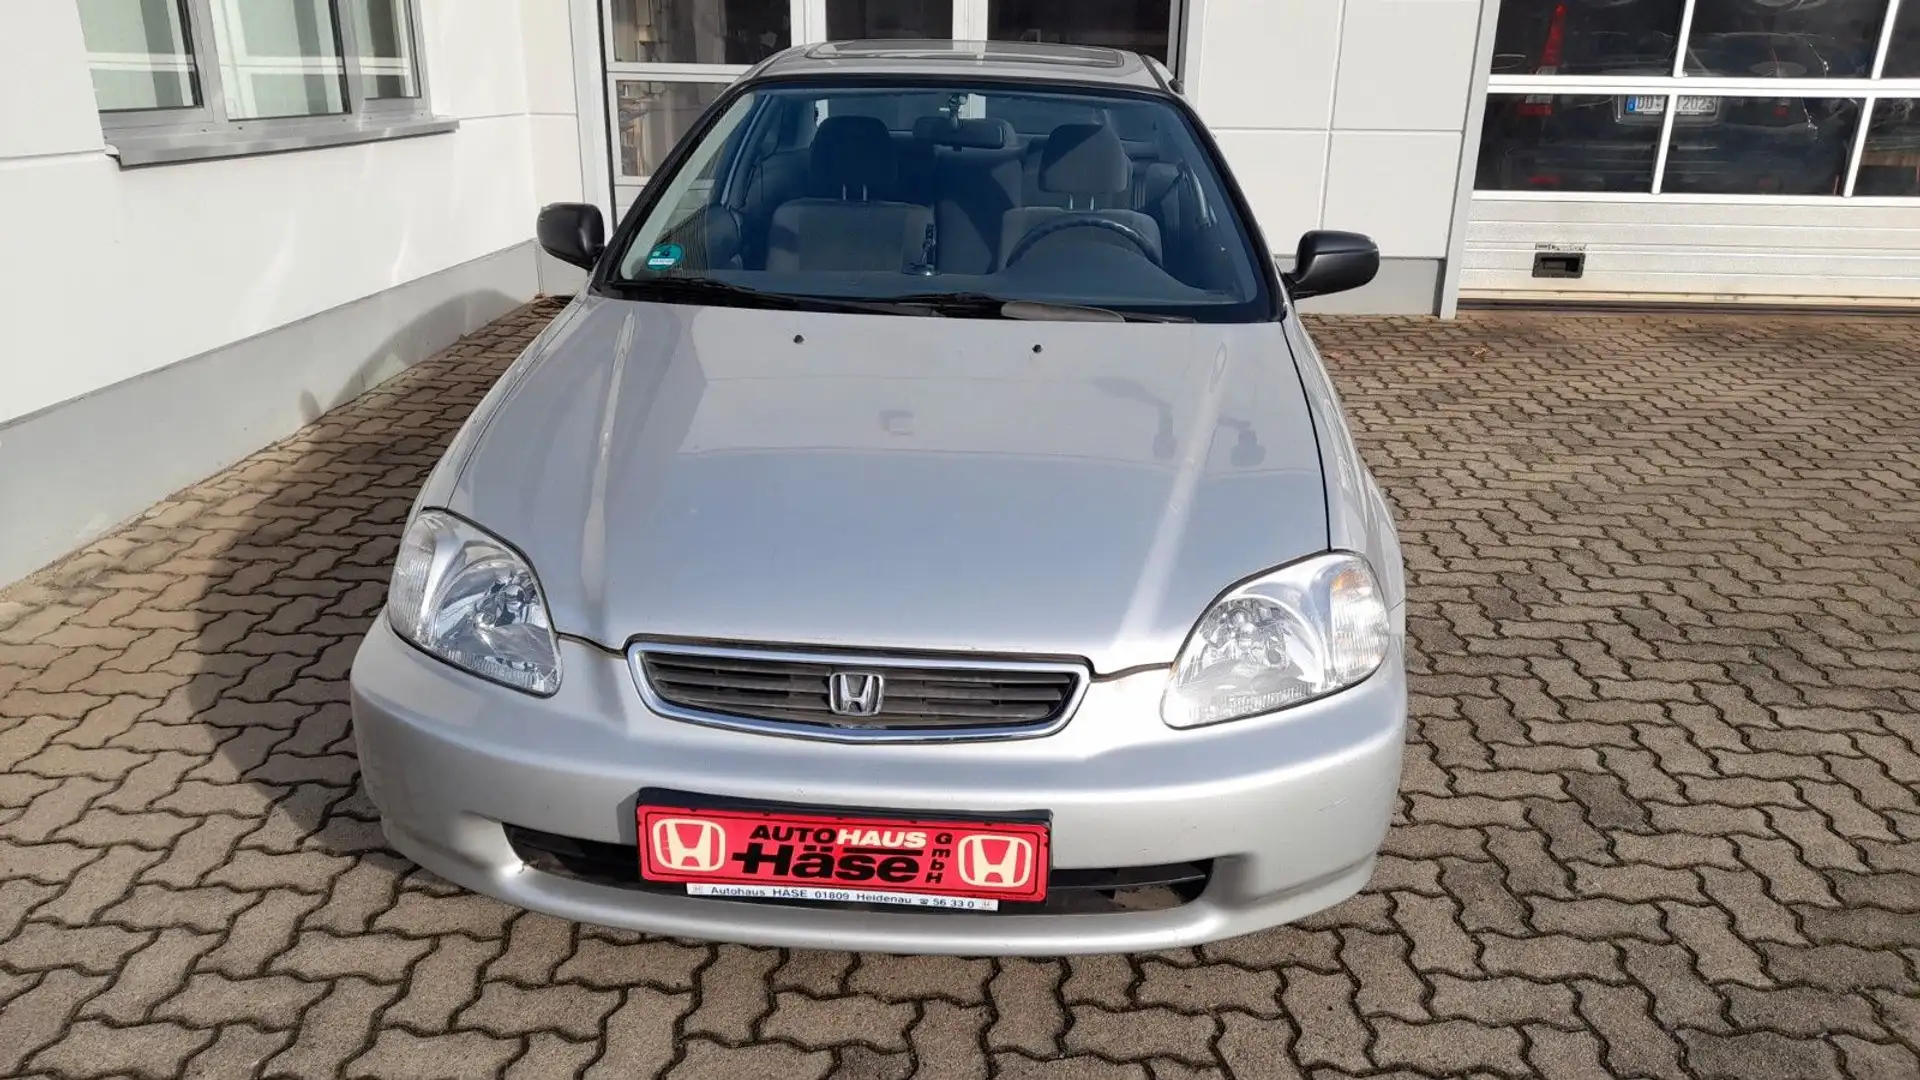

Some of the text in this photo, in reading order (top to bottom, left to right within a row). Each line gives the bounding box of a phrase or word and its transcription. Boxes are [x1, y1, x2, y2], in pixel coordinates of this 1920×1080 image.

[731, 842, 920, 883] Häse
[710, 886, 766, 897] Autohaus
[814, 891, 850, 901] 01809
[856, 893, 912, 904] Heidenau
[933, 898, 947, 907] 56
[950, 900, 964, 909] 33
